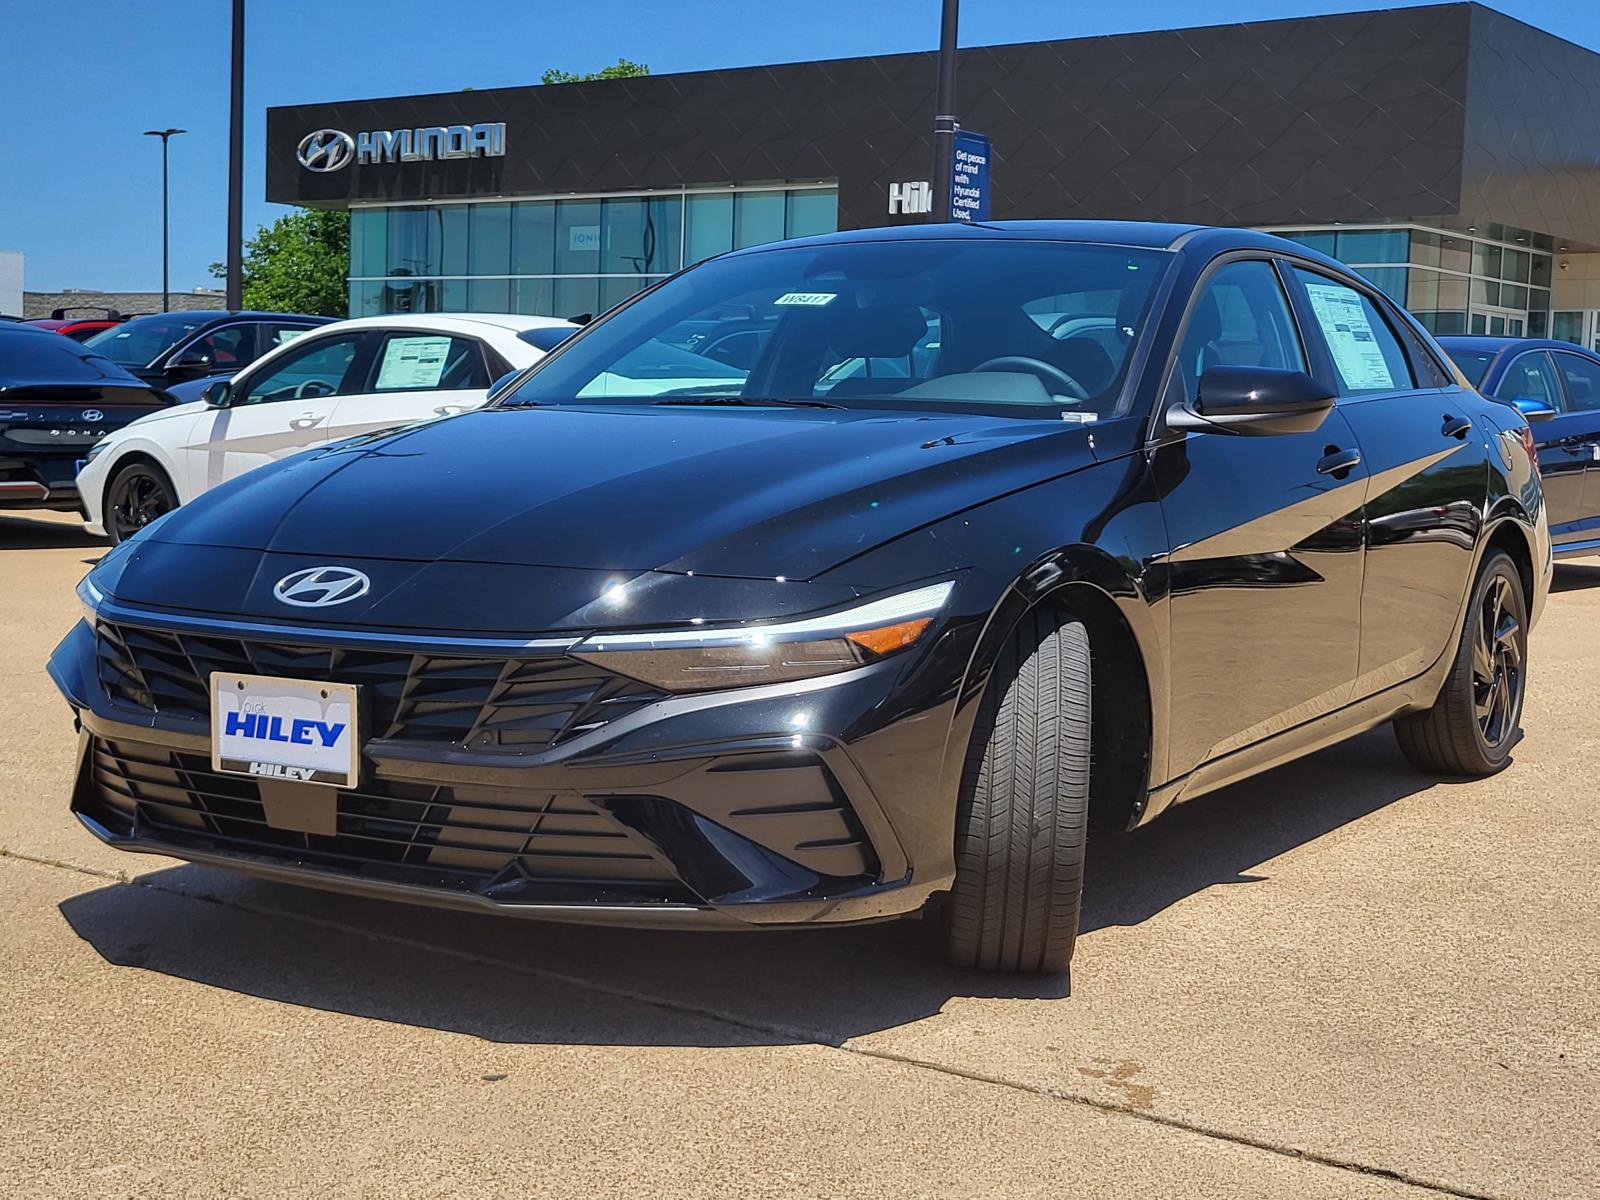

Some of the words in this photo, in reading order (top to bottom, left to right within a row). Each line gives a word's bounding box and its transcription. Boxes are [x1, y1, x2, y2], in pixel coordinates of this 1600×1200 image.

[357, 122, 507, 165] HYUNDAI
[956, 150, 968, 161] Get
[967, 154, 986, 165] peace
[955, 162, 963, 171] of
[963, 164, 978, 175] mind
[954, 174, 969, 184] with
[888, 181, 933, 214] Hil
[954, 185, 980, 198] Hyundai
[953, 196, 980, 209] Certified
[952, 208, 971, 220] Used.
[225, 711, 347, 748] HILEY
[250, 761, 317, 781] HILEY
